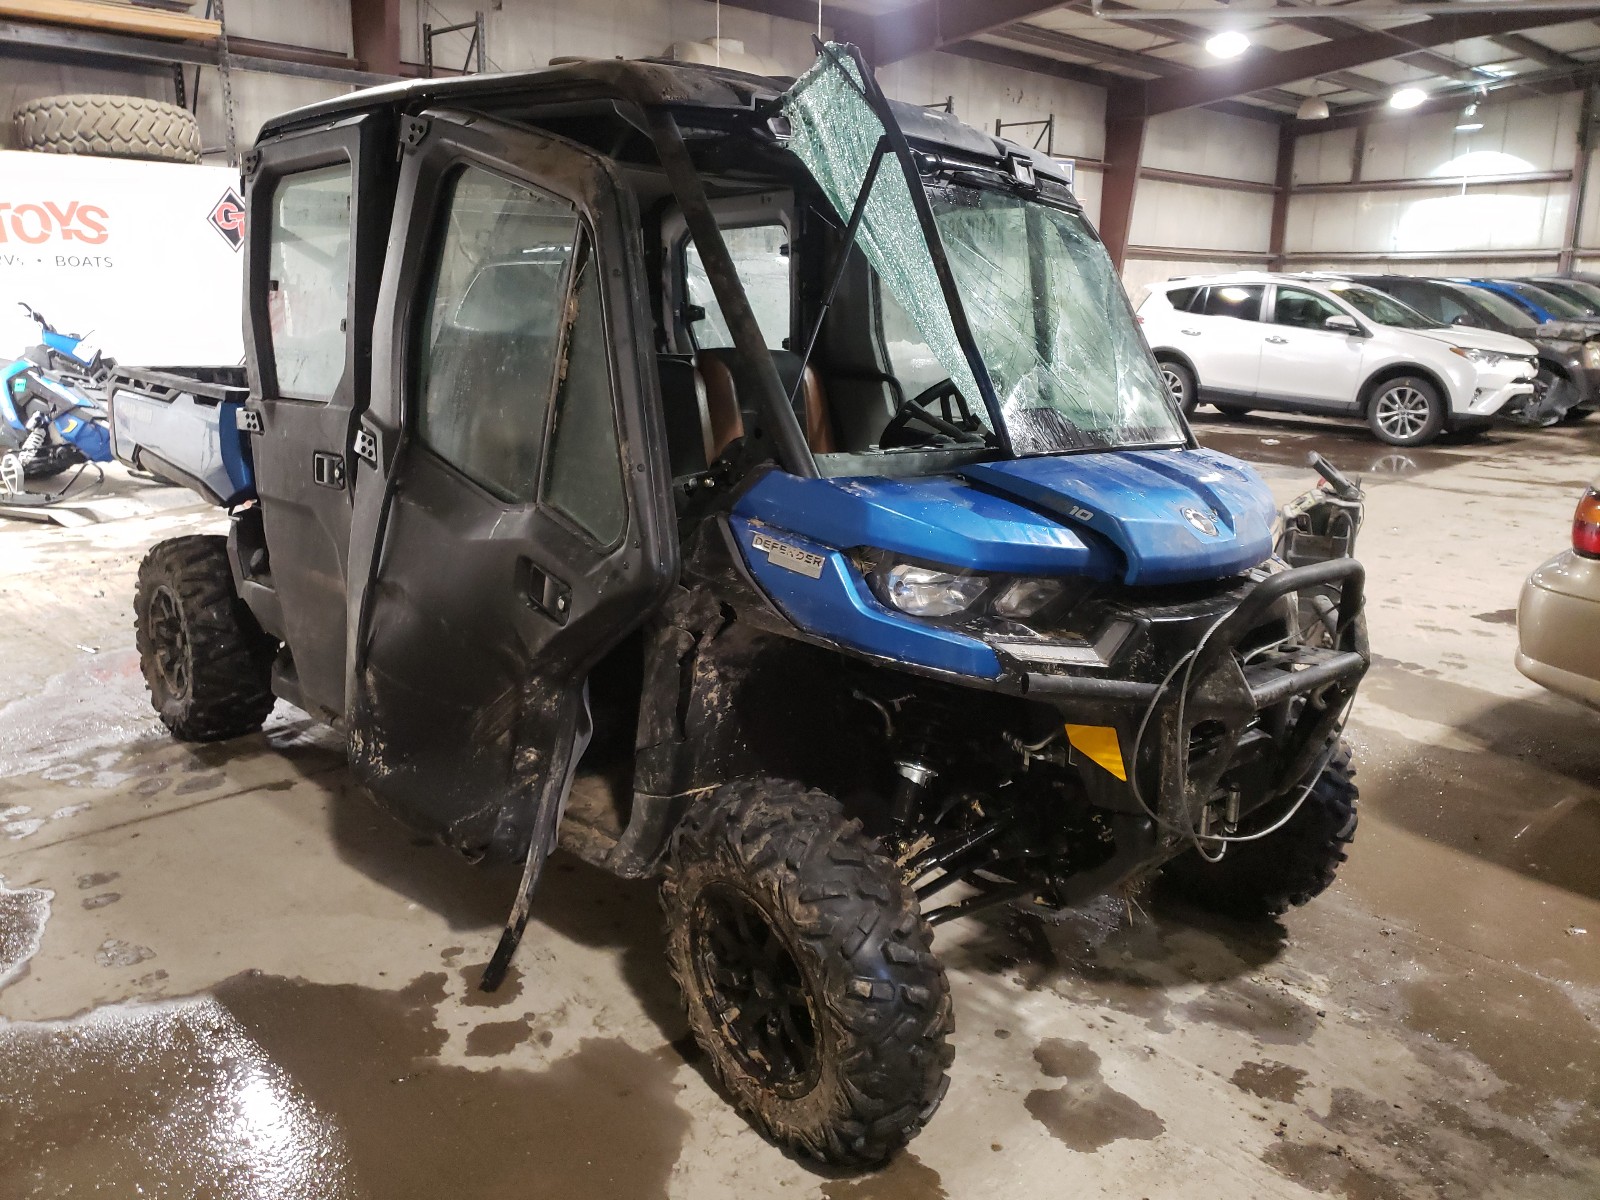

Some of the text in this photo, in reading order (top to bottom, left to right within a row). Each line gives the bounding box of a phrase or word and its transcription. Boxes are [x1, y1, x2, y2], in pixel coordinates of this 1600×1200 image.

[0, 254, 113, 268] Vs BOATS
[1069, 505, 1094, 521] 10
[755, 536, 822, 567] DEFENDER
